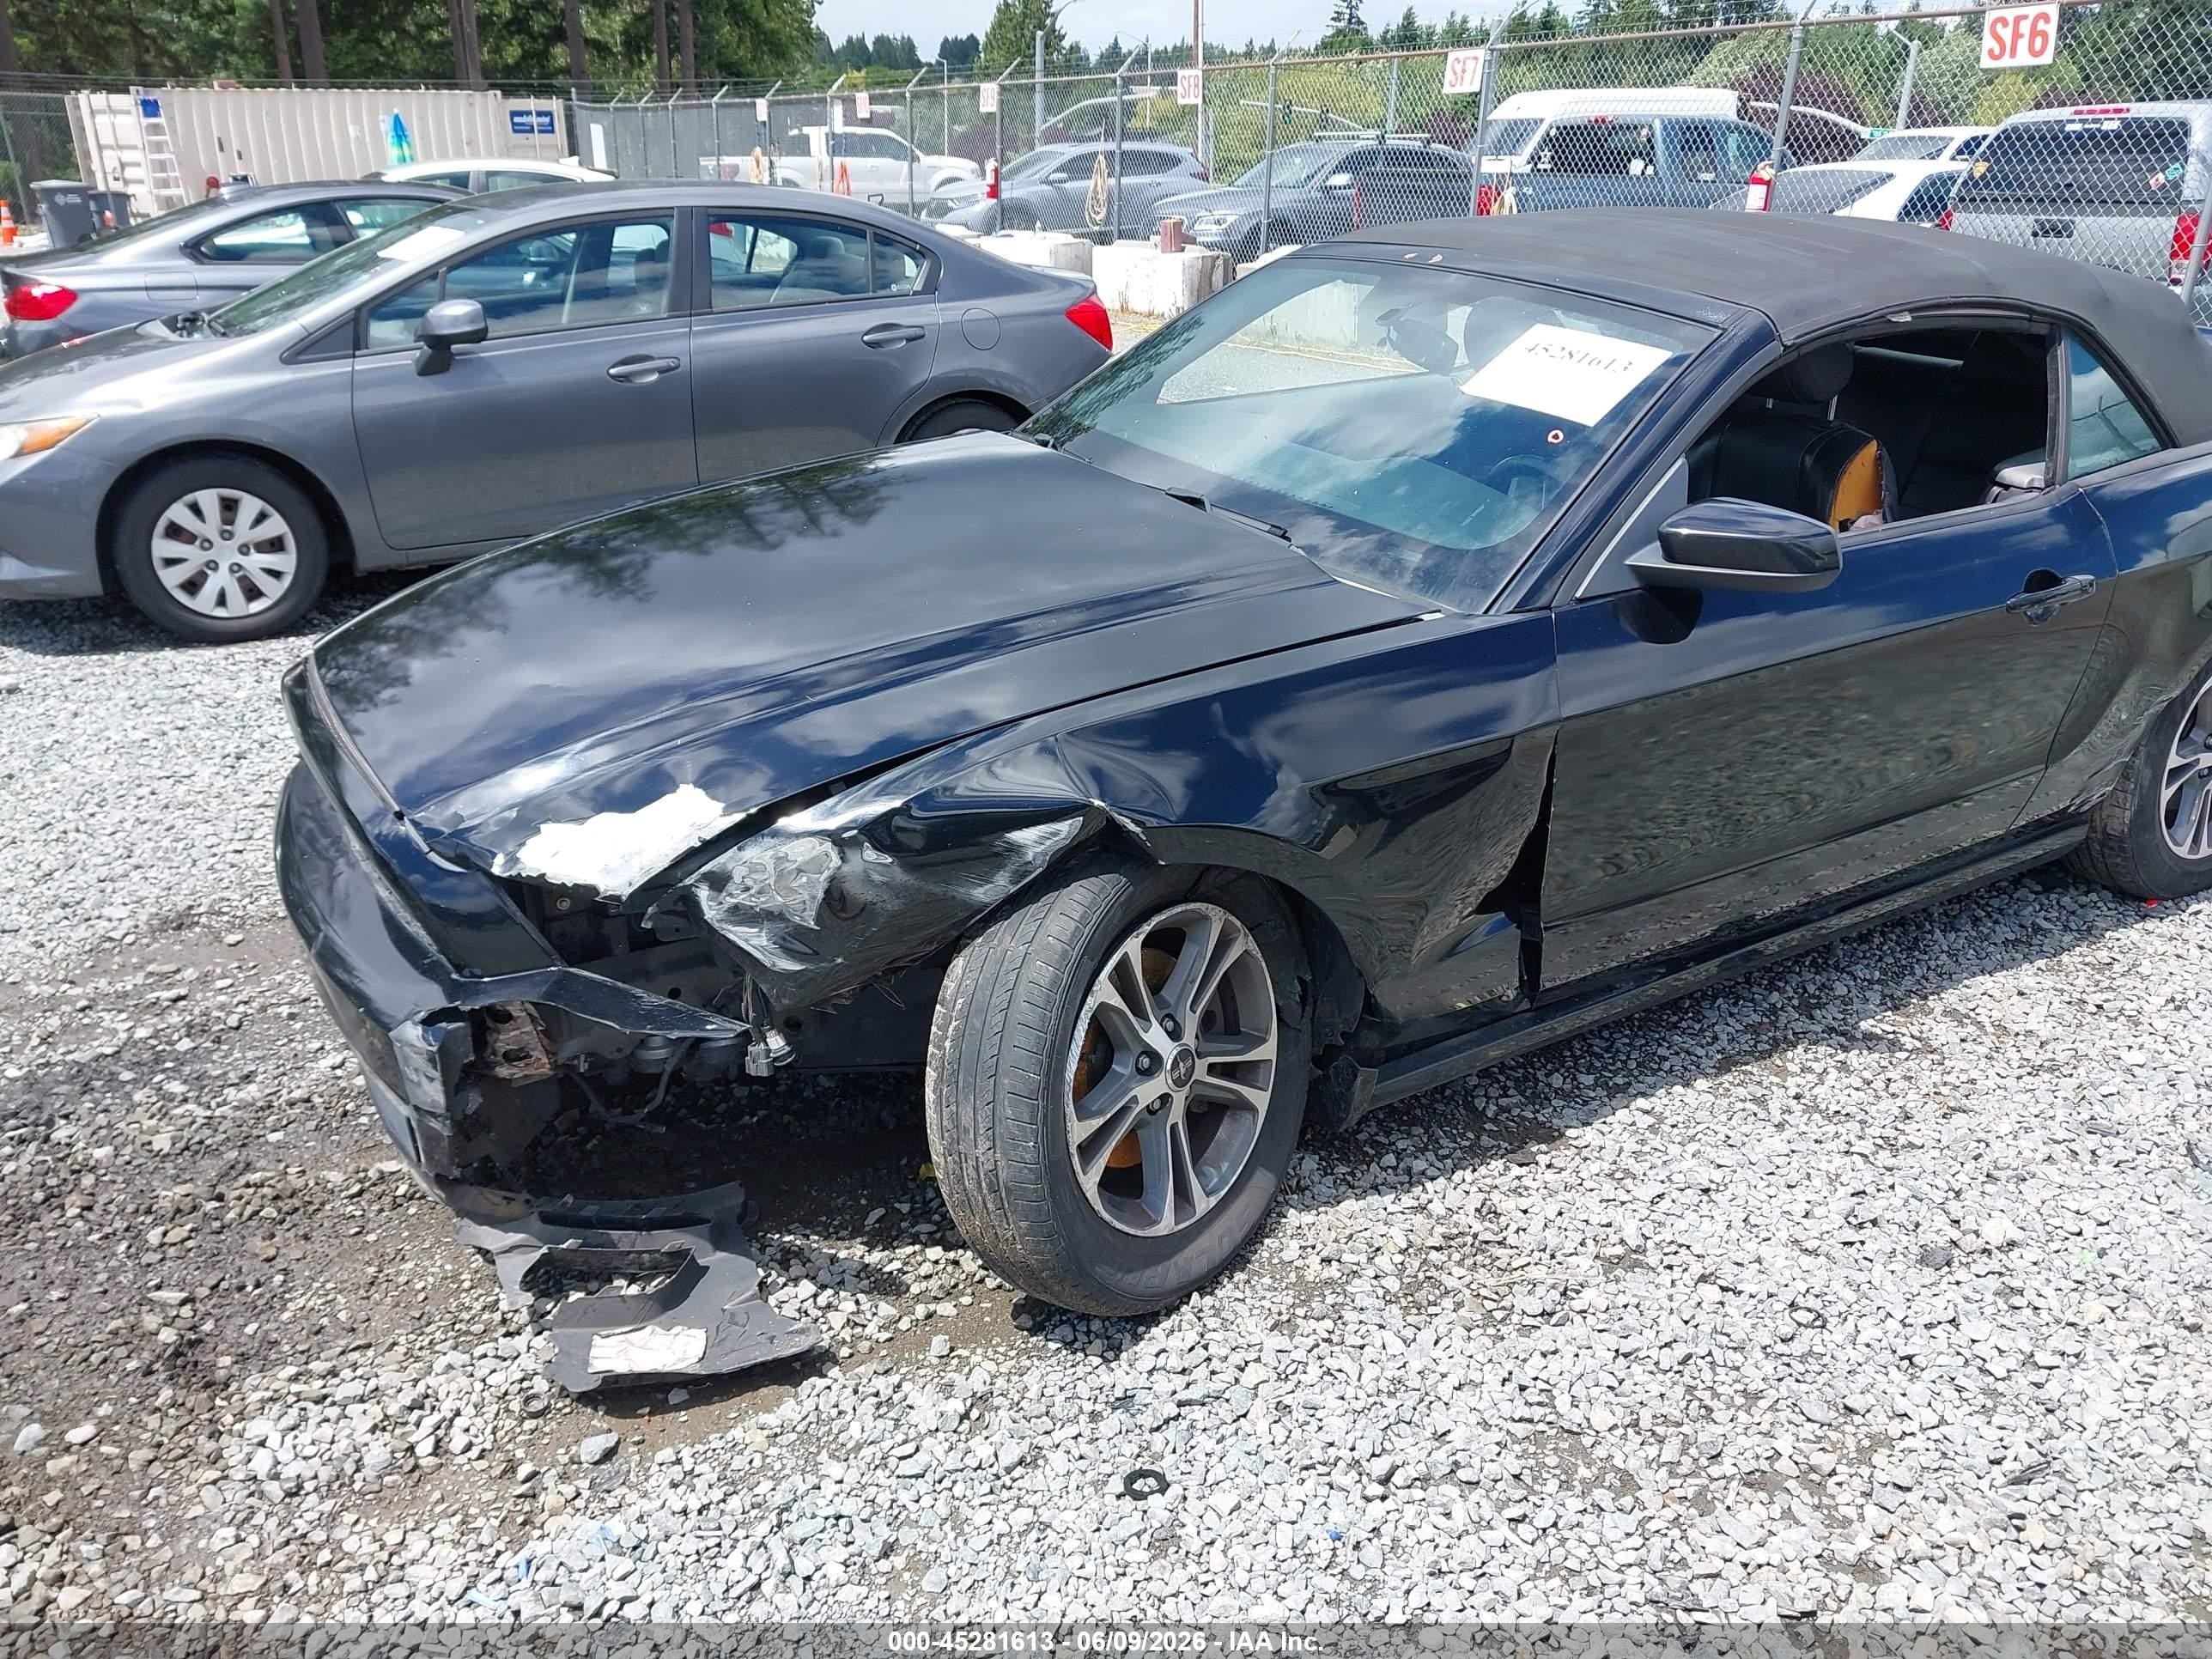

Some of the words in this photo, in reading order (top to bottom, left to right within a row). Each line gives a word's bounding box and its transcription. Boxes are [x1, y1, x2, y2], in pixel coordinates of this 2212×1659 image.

[1988, 12, 2051, 60] SF6
[1449, 56, 1479, 87] SF7
[981, 87, 995, 107] SF9
[1181, 74, 1200, 99] SF8
